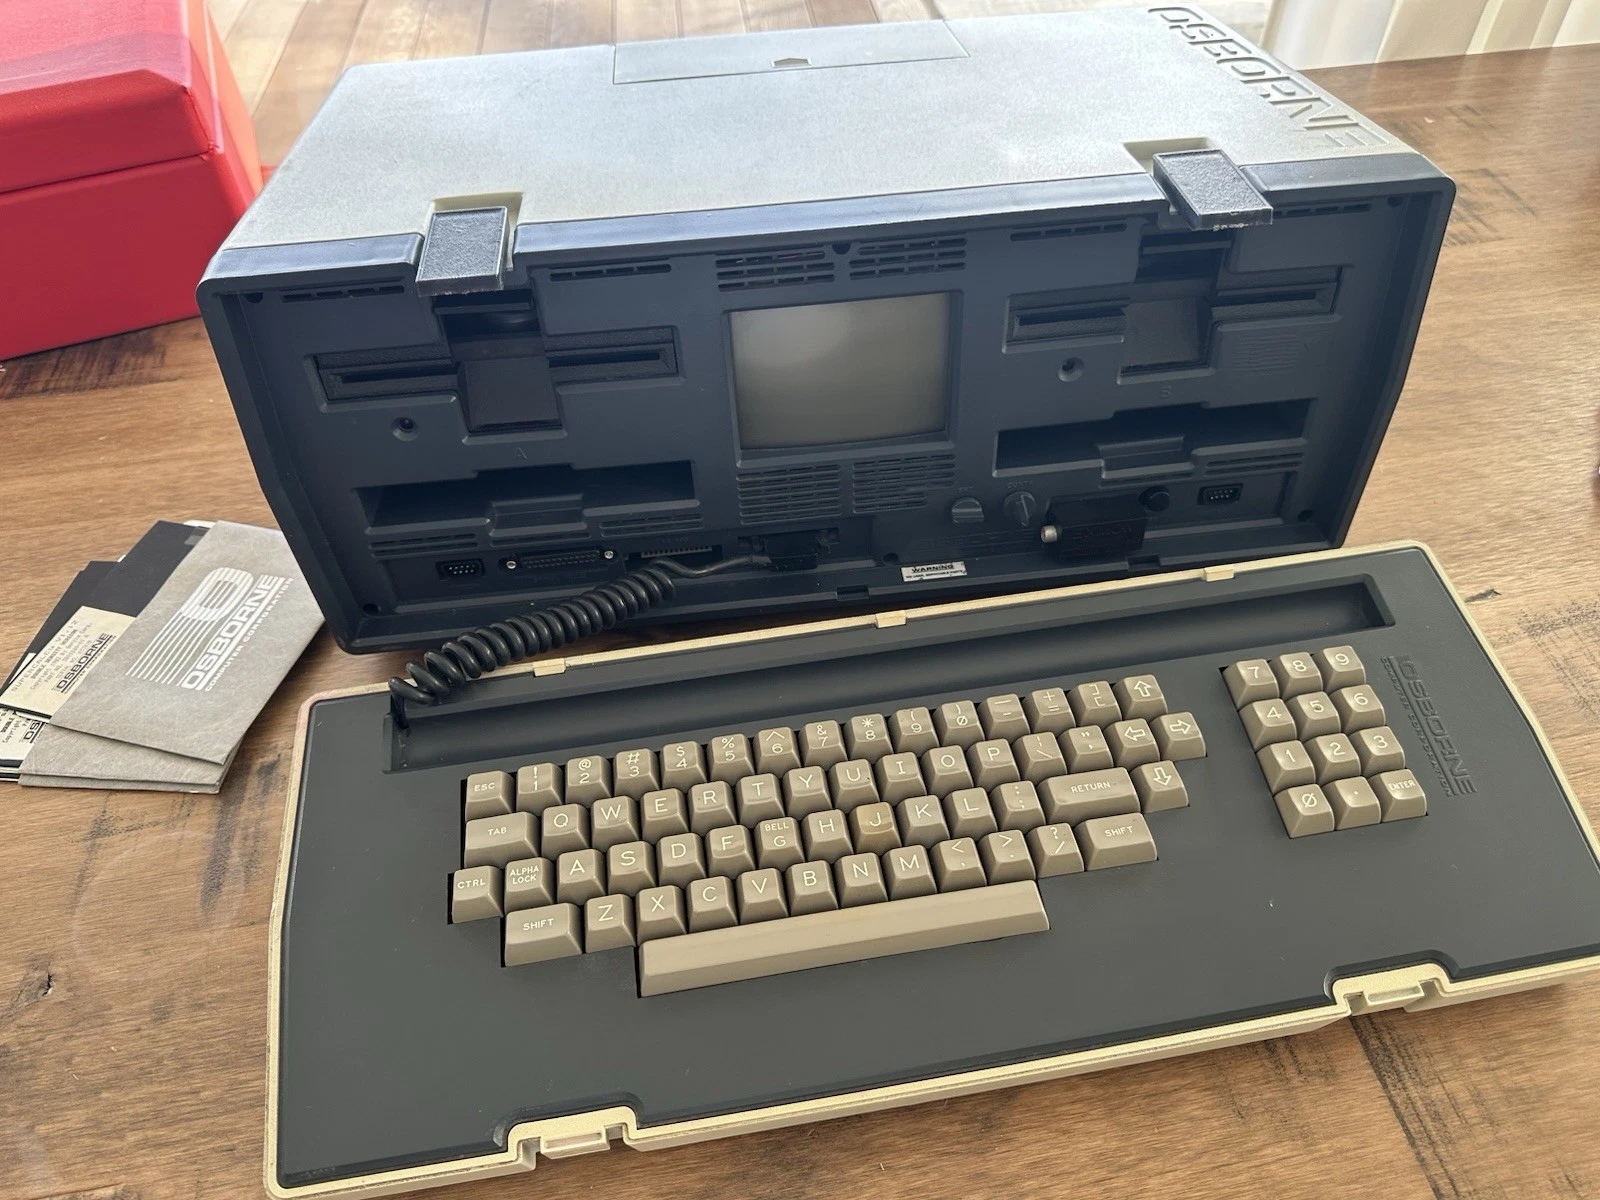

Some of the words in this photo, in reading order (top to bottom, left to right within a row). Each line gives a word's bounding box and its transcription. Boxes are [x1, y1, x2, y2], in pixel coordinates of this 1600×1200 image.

[1148, 7, 1391, 147] OSBORNE
[911, 564, 953, 572] WARNING
[180, 573, 279, 690] OSBORNE
[204, 644, 244, 691] COMPUTER
[241, 576, 294, 642] CORPORATION
[54, 632, 110, 689] OSBORNE
[1292, 660, 1307, 672] 8
[1335, 653, 1349, 666] 9
[1247, 666, 1259, 679] 7
[1043, 692, 1055, 701] +
[1353, 693, 1369, 705] 6
[1266, 706, 1282, 719] 4
[1309, 700, 1324, 713] 5
[816, 724, 827, 735] &
[911, 723, 922, 733] 9
[1398, 660, 1478, 795] OSBORNE
[866, 730, 875, 740] 8
[1373, 735, 1388, 748] 3
[722, 737, 734, 749] %
[772, 744, 783, 753] 6
[818, 737, 828, 747] 7
[676, 746, 685, 757] $
[725, 750, 735, 761] 5
[987, 747, 1000, 761] P
[1330, 742, 1346, 756] 2
[626, 752, 640, 764] #
[940, 754, 955, 768] O
[1285, 749, 1296, 763] 1
[579, 759, 592, 771] @
[676, 758, 687, 768] 4
[897, 761, 906, 774] I
[533, 767, 538, 778] !
[579, 773, 589, 783] 2
[629, 766, 640, 777] 3
[846, 768, 861, 782] U
[474, 782, 495, 791] ESC
[534, 780, 538, 791] 1
[799, 774, 813, 789] Y
[1070, 781, 1111, 794] RETURN
[1388, 779, 1416, 791] ENTER
[752, 783, 765, 797] T
[703, 791, 717, 805] R
[654, 798, 668, 813] E
[915, 803, 932, 819] K
[963, 798, 979, 812] L
[600, 805, 621, 821] W
[870, 812, 881, 827] J
[553, 813, 569, 828] Q
[764, 821, 789, 831] BELL
[819, 818, 835, 833] H
[487, 826, 507, 836] TAB
[1050, 827, 1059, 840] ?
[1104, 826, 1133, 837] SHIFT
[721, 835, 734, 850] F
[773, 836, 786, 847] G
[951, 840, 964, 853] <
[999, 834, 1013, 847] >
[671, 843, 686, 859] D
[1055, 841, 1065, 854] /
[620, 850, 636, 866] S
[900, 854, 920, 871] M
[509, 865, 540, 876] ALPHA
[569, 859, 585, 876] A
[853, 862, 869, 879] N
[457, 878, 486, 889] CTRL
[512, 873, 537, 885] LOCK
[803, 870, 817, 886] B
[751, 877, 768, 894] V
[702, 886, 718, 902] C
[651, 895, 666, 912] X
[598, 904, 614, 922] Z
[523, 918, 554, 931] SHIFT
